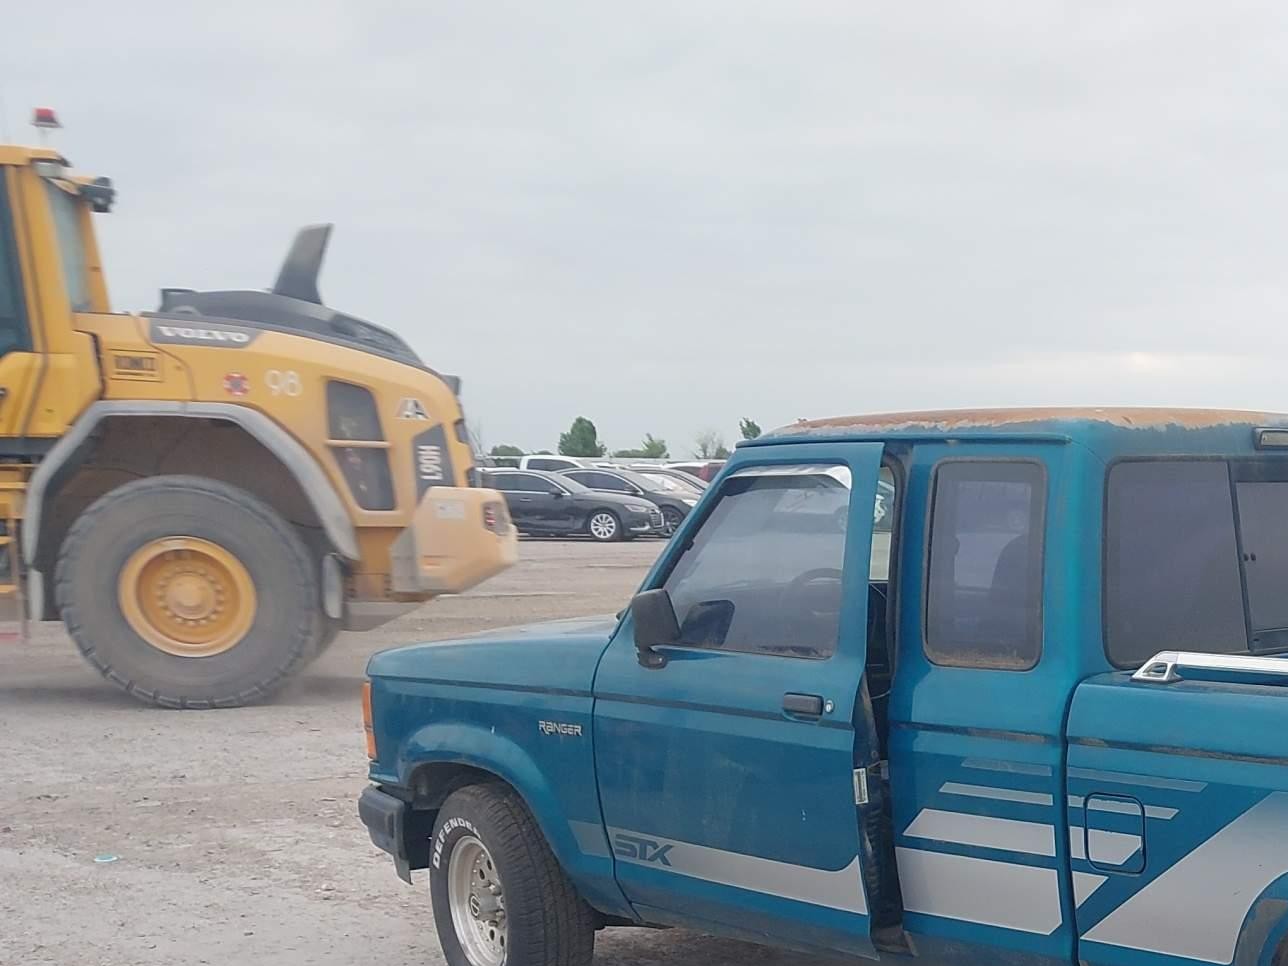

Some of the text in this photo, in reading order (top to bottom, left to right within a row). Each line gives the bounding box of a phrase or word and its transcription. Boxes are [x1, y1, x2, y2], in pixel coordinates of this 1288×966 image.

[157, 325, 250, 343] VOLVO
[264, 368, 303, 397] 98
[416, 444, 444, 481] L90H
[538, 720, 583, 737] RANGER
[432, 817, 482, 870] DEFENDE
[615, 833, 674, 867] STX
